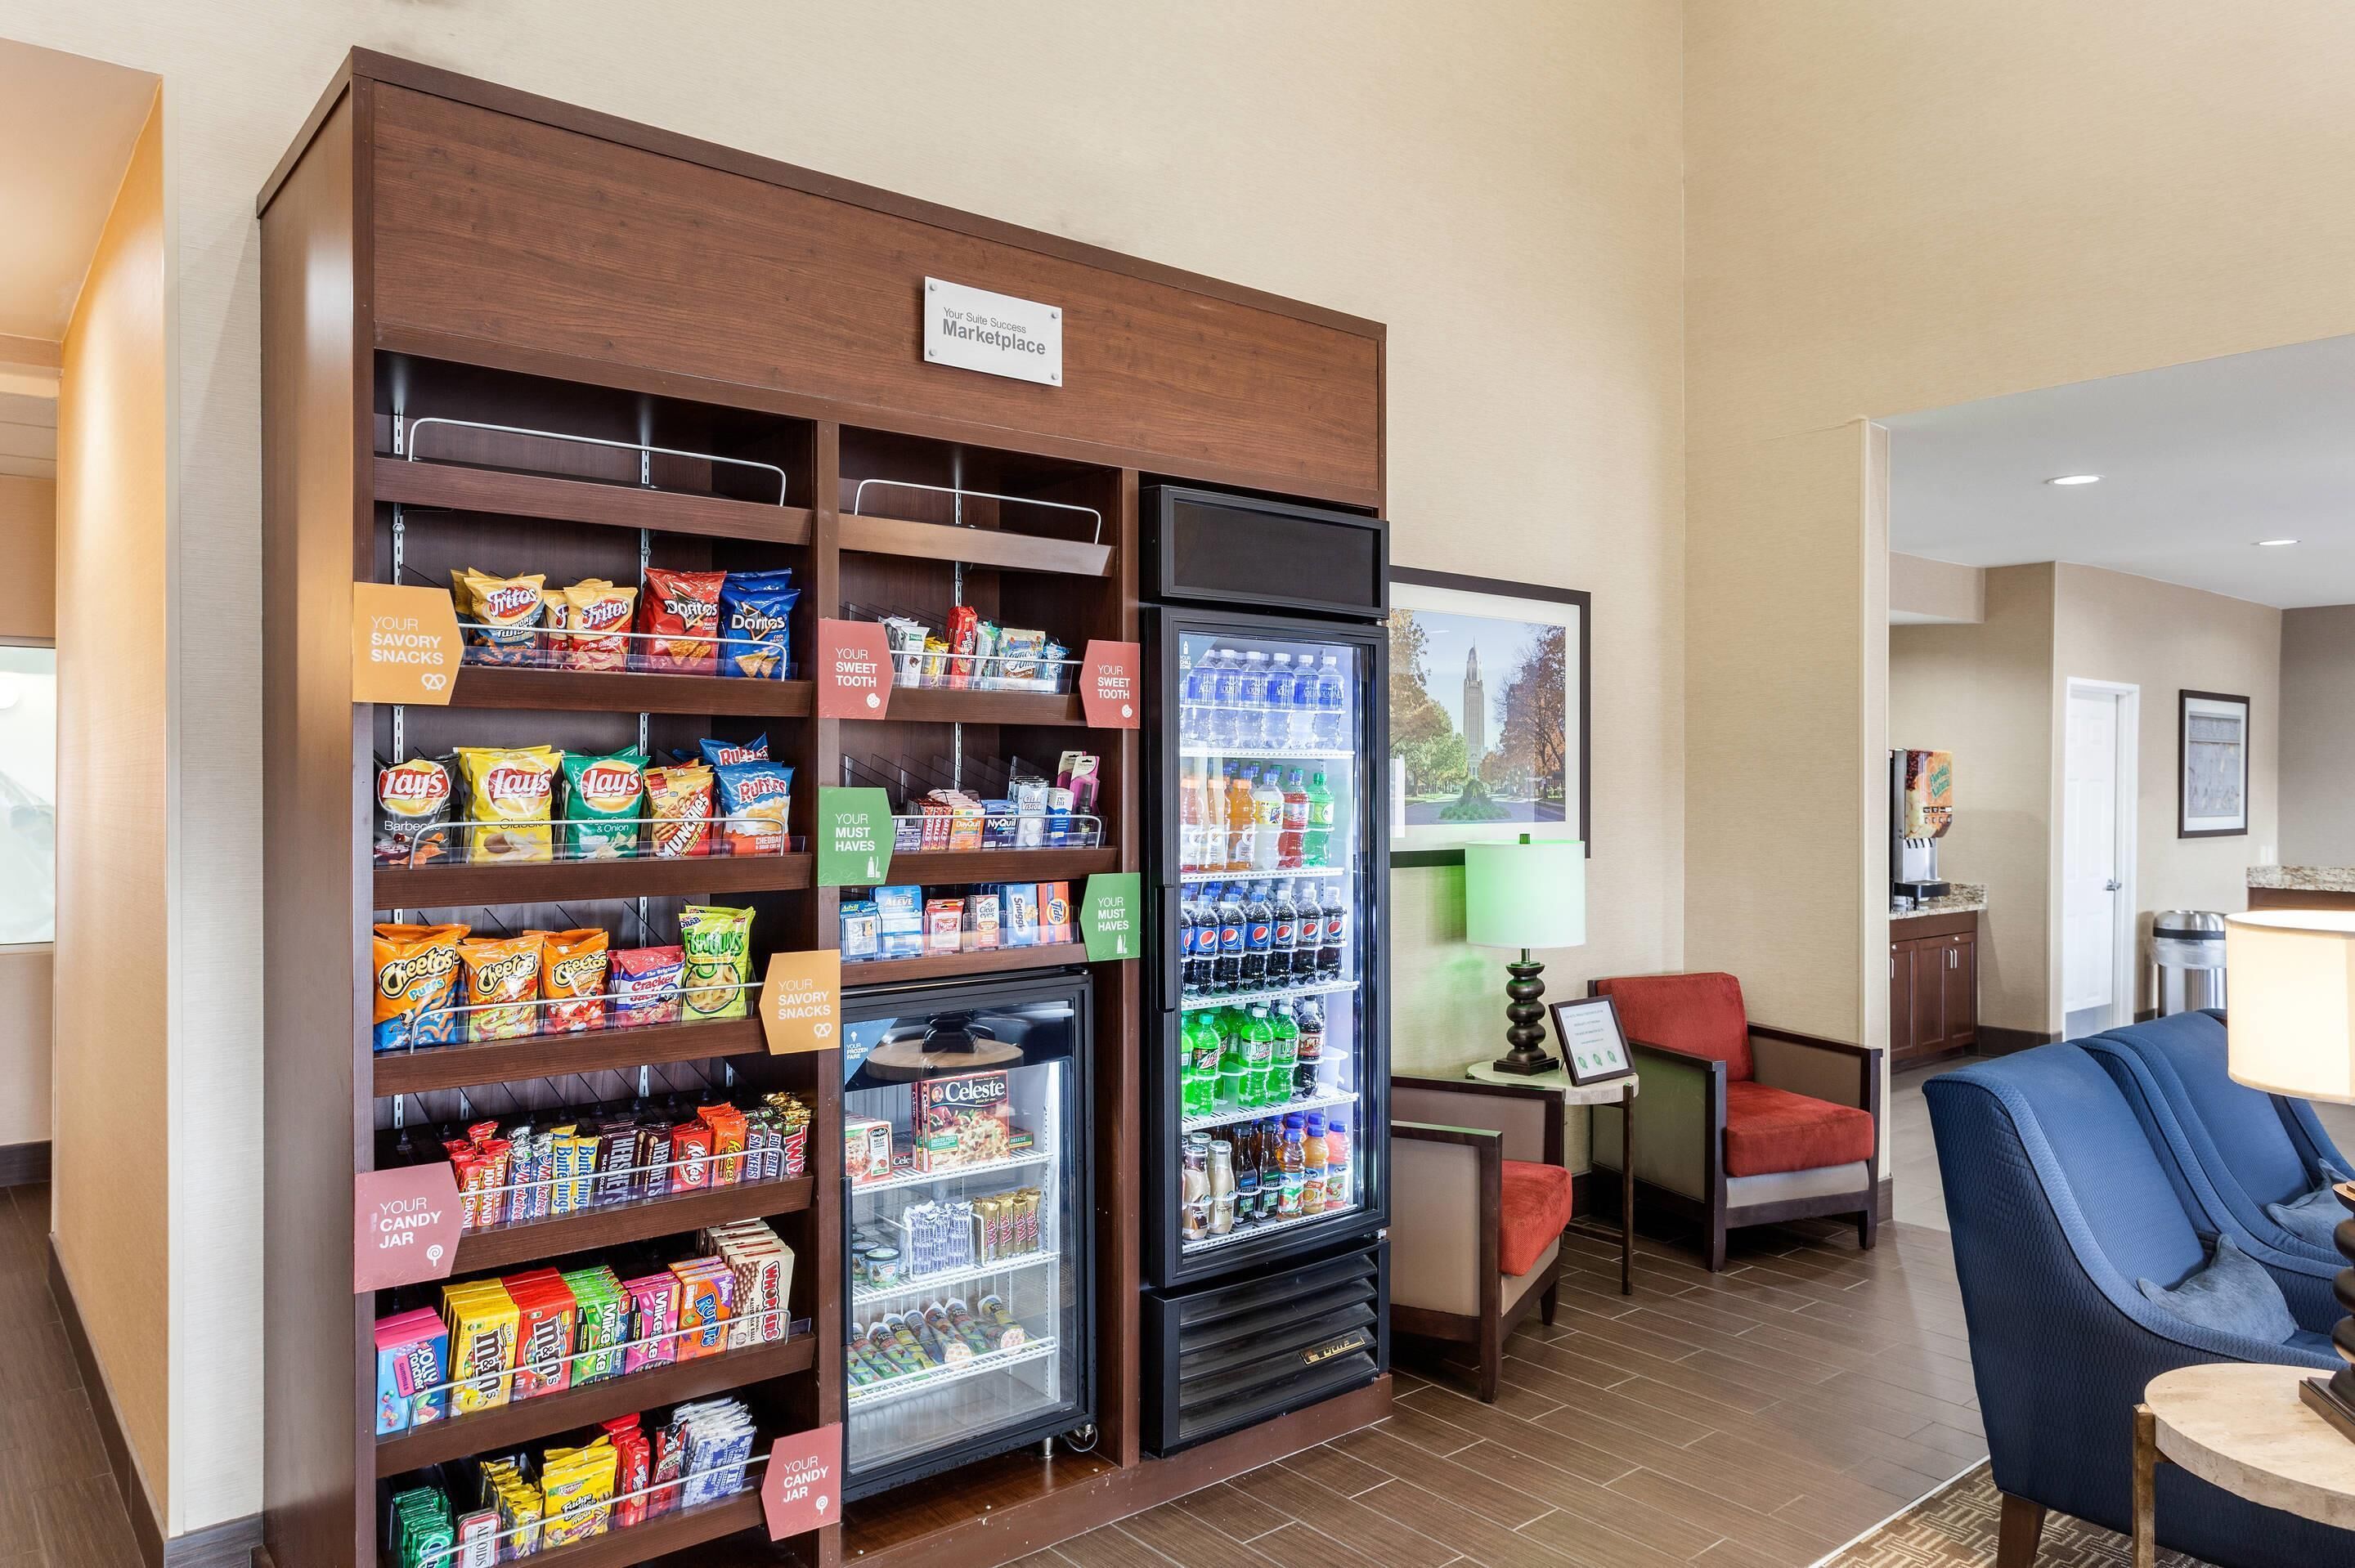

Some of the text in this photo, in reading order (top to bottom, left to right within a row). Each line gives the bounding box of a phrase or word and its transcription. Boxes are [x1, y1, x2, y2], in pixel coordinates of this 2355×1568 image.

[944, 307, 1026, 334] Your Suite Success
[943, 318, 1046, 356] Marketplace
[487, 589, 537, 616] Fritos
[666, 600, 717, 616] Doritos
[371, 616, 419, 631] YOUR
[581, 601, 628, 629] Fritos
[732, 614, 785, 629] Doritos
[371, 633, 442, 648] SAVORY
[599, 636, 623, 647] ORIGINA
[371, 649, 444, 665] SNACKS
[836, 647, 868, 660] YOUR
[836, 661, 877, 674] SWEET
[1097, 665, 1124, 675] YOUR
[836, 675, 877, 688] TOOTH
[1097, 677, 1130, 688] SWEET
[1097, 688, 1130, 700] TOOTH
[718, 746, 769, 766] RUFFLES
[383, 771, 444, 800] Lay's
[493, 768, 551, 799] Lay's
[586, 769, 639, 798] Lay's
[738, 777, 787, 803] RUFFLES
[836, 813, 868, 824] YOUR
[956, 820, 981, 829] DayQuil
[988, 818, 1016, 831] NyQuil
[604, 824, 629, 832] Onion
[836, 827, 870, 838] MUST
[756, 836, 782, 844] CHEDDA
[836, 840, 875, 851] HAVES
[1051, 900, 1064, 922] Tide
[1097, 897, 1124, 907] YOUR
[680, 916, 701, 929] GRAB
[1097, 908, 1126, 920] MUST
[1097, 921, 1129, 932] HAVES
[380, 947, 455, 997] Cheetos
[477, 952, 536, 995] Cheetos
[553, 952, 608, 987] Cheetos
[657, 965, 679, 974] Original
[408, 979, 445, 1001] Puffs
[631, 974, 677, 992] Cracker
[778, 979, 812, 991] YOUR
[778, 992, 829, 1006] SAVORY
[778, 1005, 831, 1020] SNACKS
[847, 1047, 868, 1055] FROZEN
[945, 1079, 1006, 1102] Celeste
[894, 1156, 912, 1166] Cele
[554, 1146, 572, 1214] Buttefinge
[574, 1145, 595, 1210] Butterfing
[603, 1137, 635, 1205] HERSHEY'S
[598, 1166, 607, 1195] CCOLATE
[481, 1168, 495, 1224] 100 GRAND
[512, 1172, 528, 1221] Msketee
[536, 1166, 551, 1217] Muketeer
[379, 1198, 427, 1215] YOUR
[379, 1211, 442, 1232] CANDY
[379, 1232, 414, 1248] JAR
[648, 1290, 669, 1360] Mike ke
[695, 1292, 720, 1347] RUNTS
[594, 1302, 617, 1372] Mike ke
[533, 1316, 563, 1386] m&m's
[409, 1352, 425, 1390] rancher
[418, 1347, 438, 1383] JOLLY
[473, 1329, 502, 1399] m&m's
[784, 1455, 819, 1473] YOUR
[783, 1466, 829, 1488] CANDY
[562, 1494, 593, 1512] Fudge
[783, 1486, 808, 1503] JAR
[476, 1525, 490, 1566] ALOIDS
